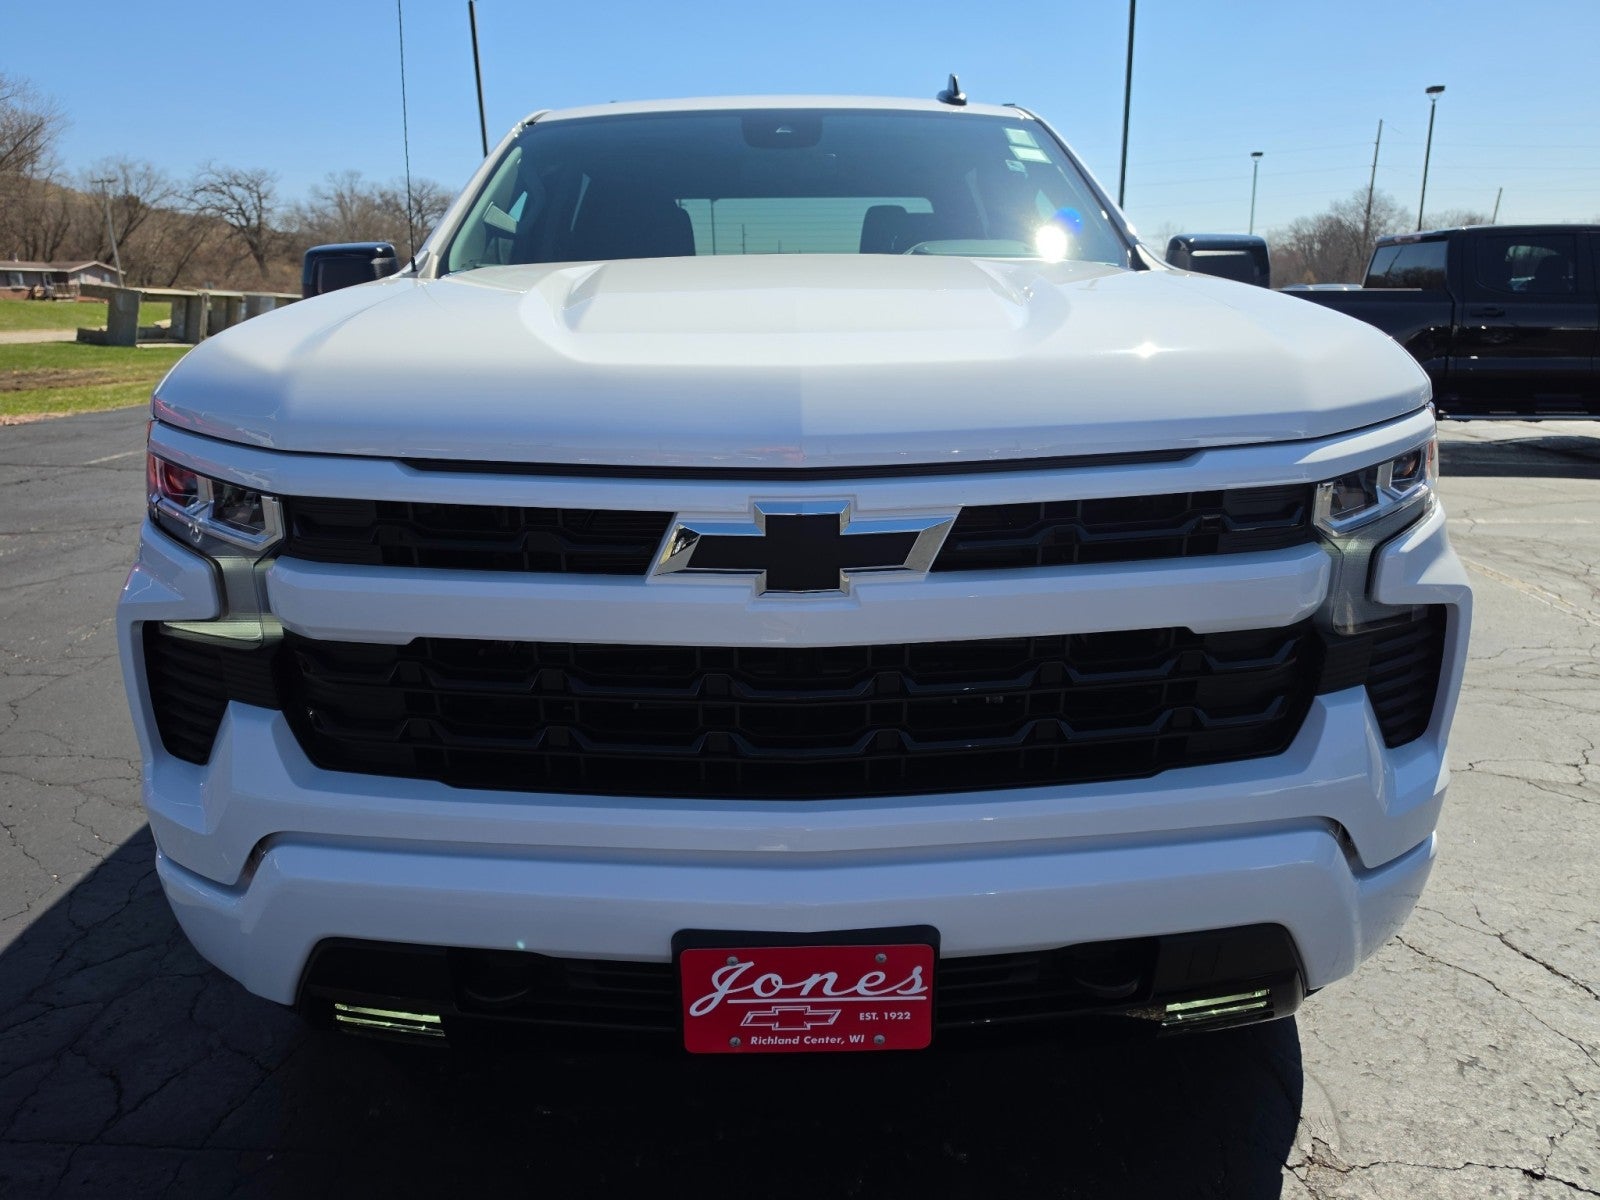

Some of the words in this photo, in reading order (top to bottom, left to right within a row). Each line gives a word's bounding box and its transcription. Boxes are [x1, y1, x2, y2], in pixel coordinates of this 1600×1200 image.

[689, 961, 929, 1017] Jones
[859, 1011, 879, 1021] EST.
[883, 1011, 911, 1020] 1922
[750, 1036, 800, 1046] Richland
[803, 1035, 845, 1045] Center,
[849, 1034, 865, 1044] WI
